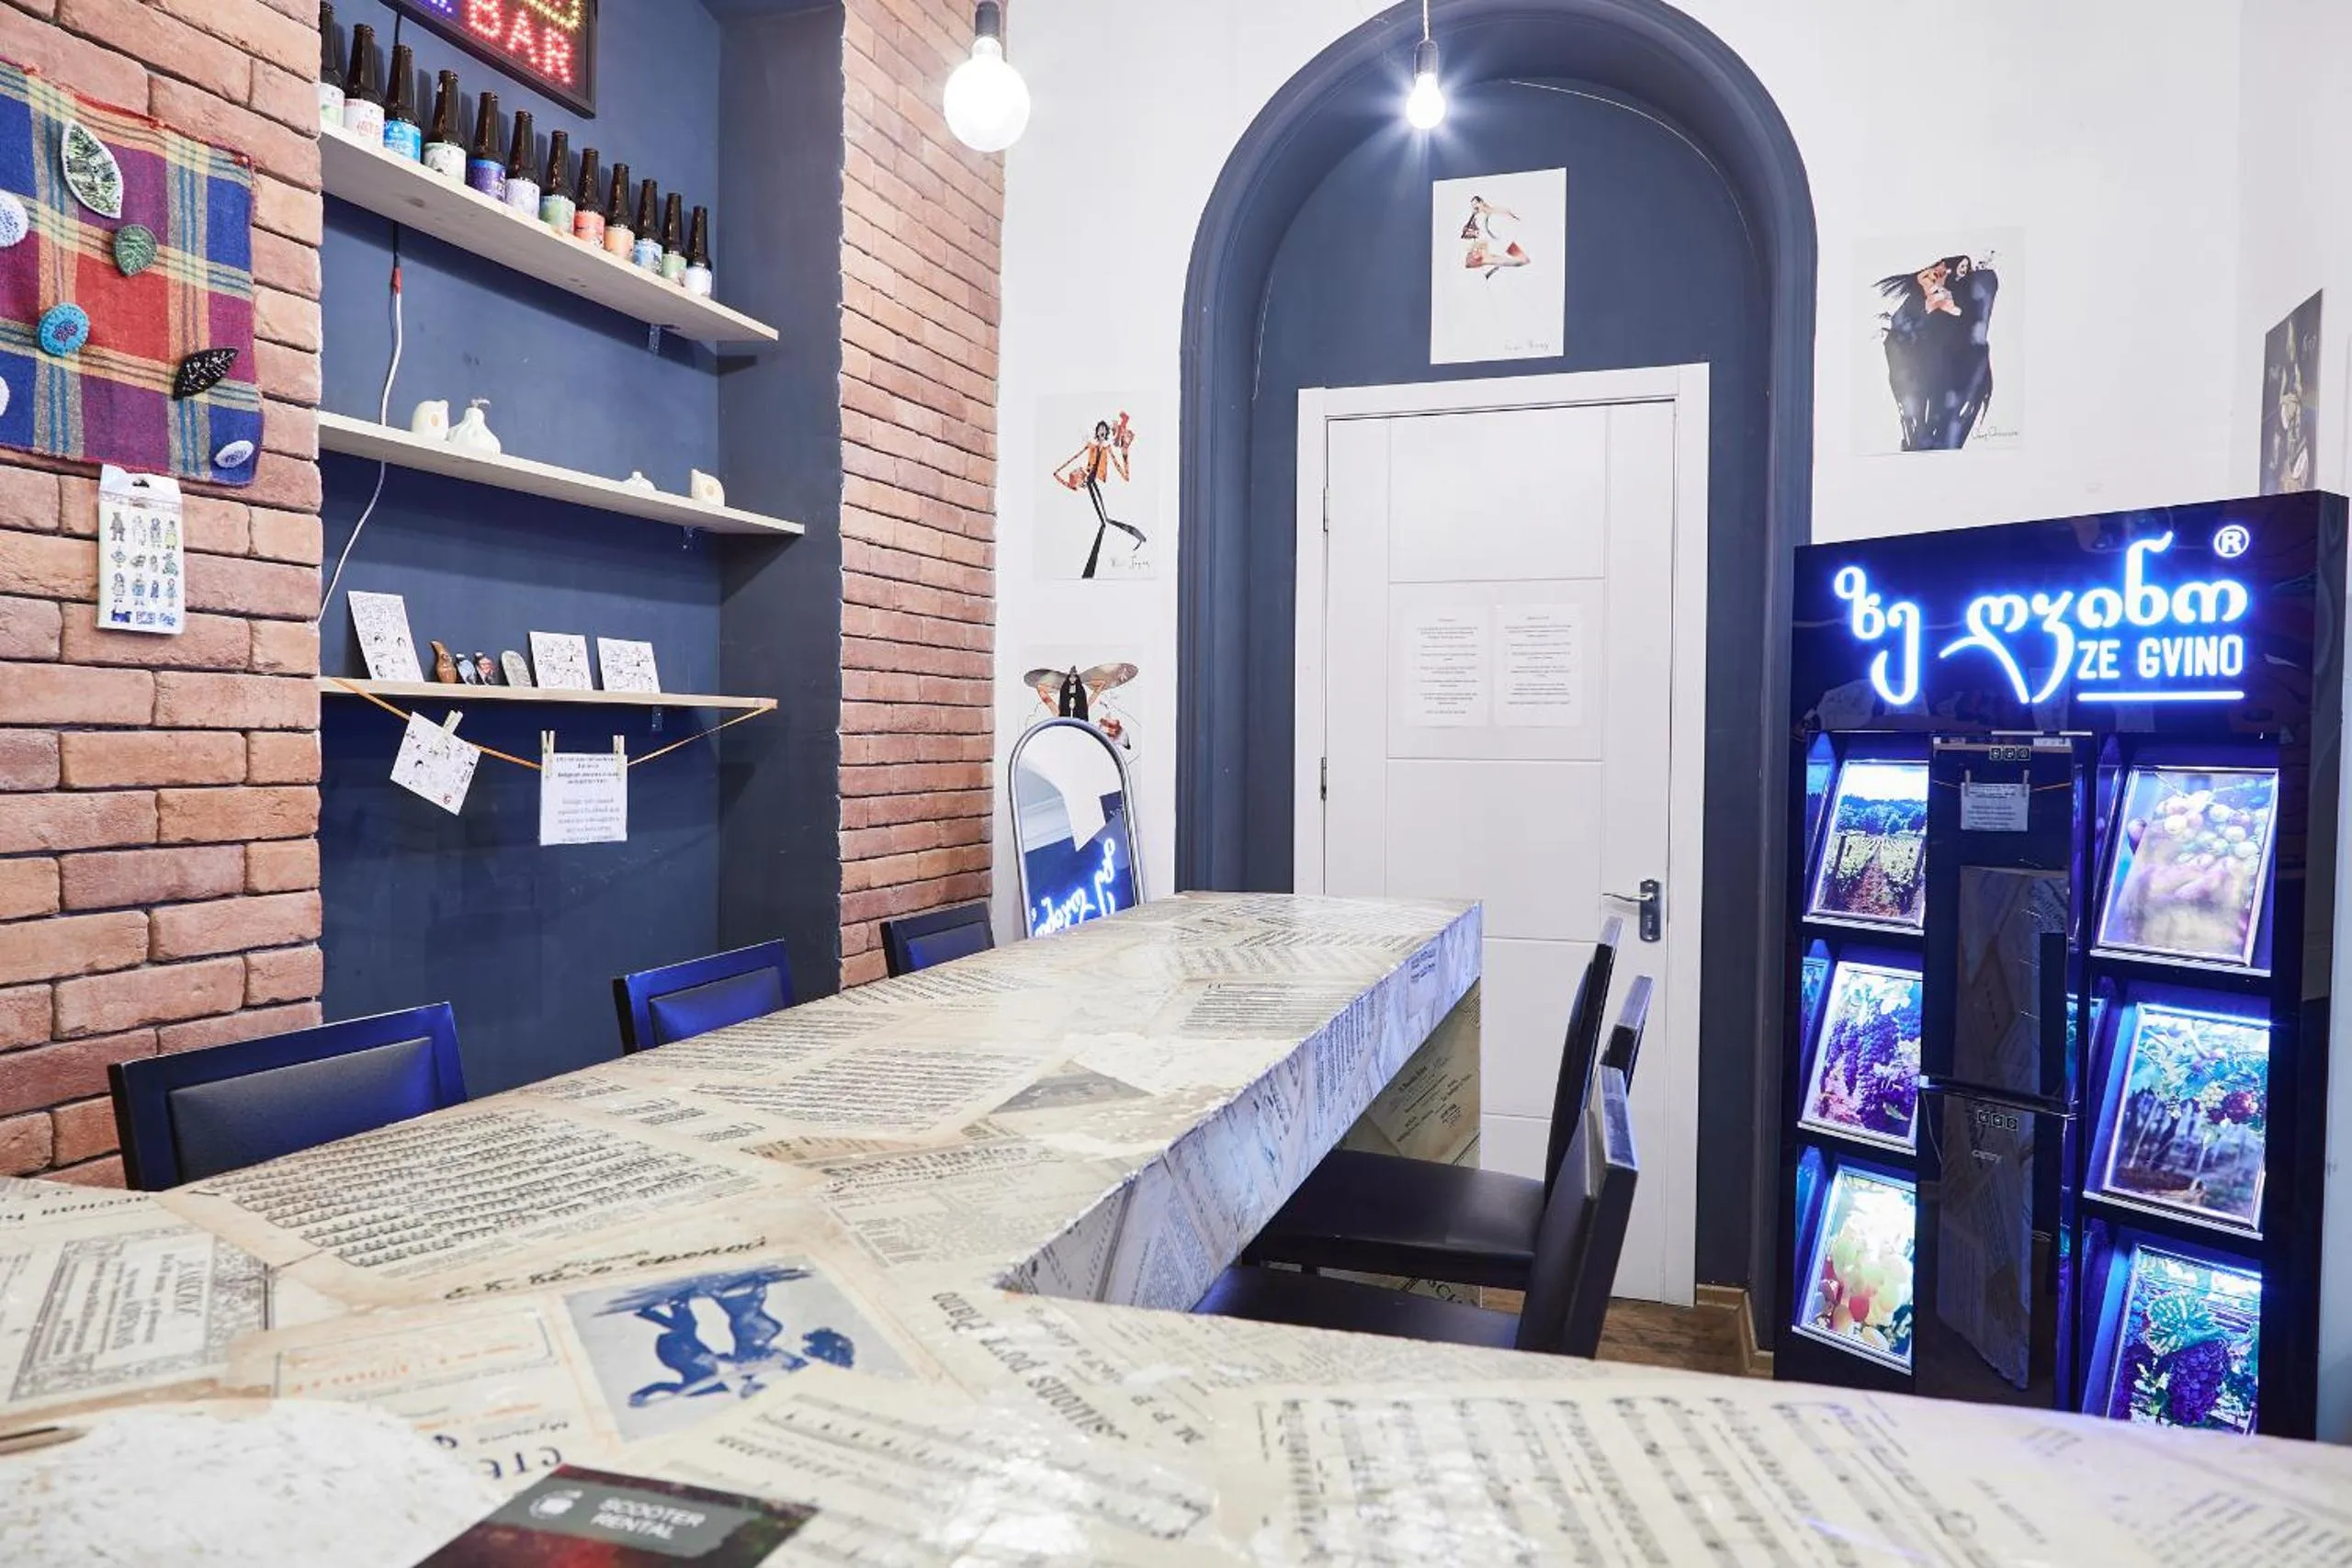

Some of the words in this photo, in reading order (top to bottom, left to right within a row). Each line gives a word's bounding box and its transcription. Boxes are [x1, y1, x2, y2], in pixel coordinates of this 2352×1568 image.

[1834, 566, 1920, 705] ზე
[1939, 531, 2248, 704] ღვინო
[2076, 639, 2120, 679] ZE
[2137, 635, 2245, 677] GVINO
[589, 1512, 677, 1540] RENTAL
[597, 1496, 707, 1529] SCOOTER
